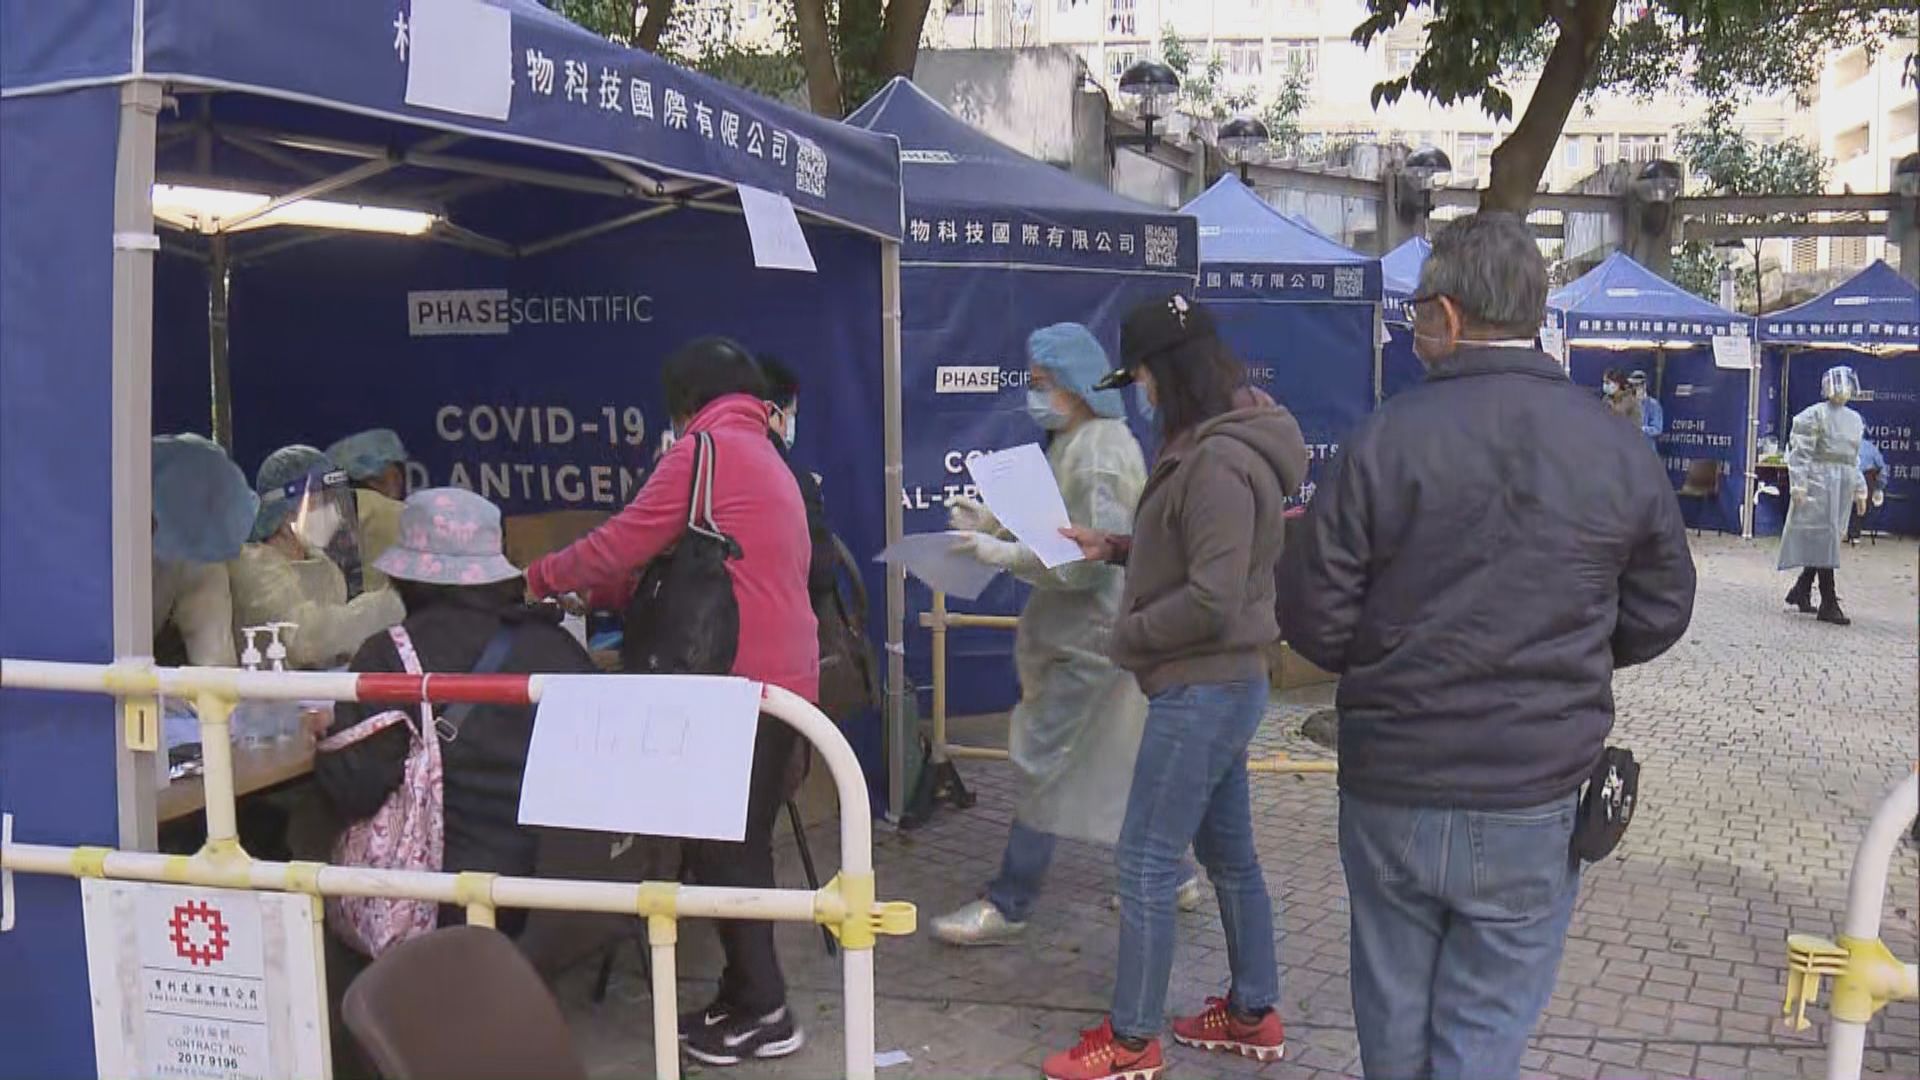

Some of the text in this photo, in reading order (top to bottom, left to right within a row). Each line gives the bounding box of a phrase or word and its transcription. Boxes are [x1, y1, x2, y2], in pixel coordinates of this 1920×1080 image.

[910, 219, 1136, 256] 物科技國際有限公司
[1197, 271, 1326, 290] 國際有限公司
[435, 404, 645, 446] COVID-19
[1866, 425, 1911, 437] VID-19
[167, 1039, 223, 1053] CONTRACT
